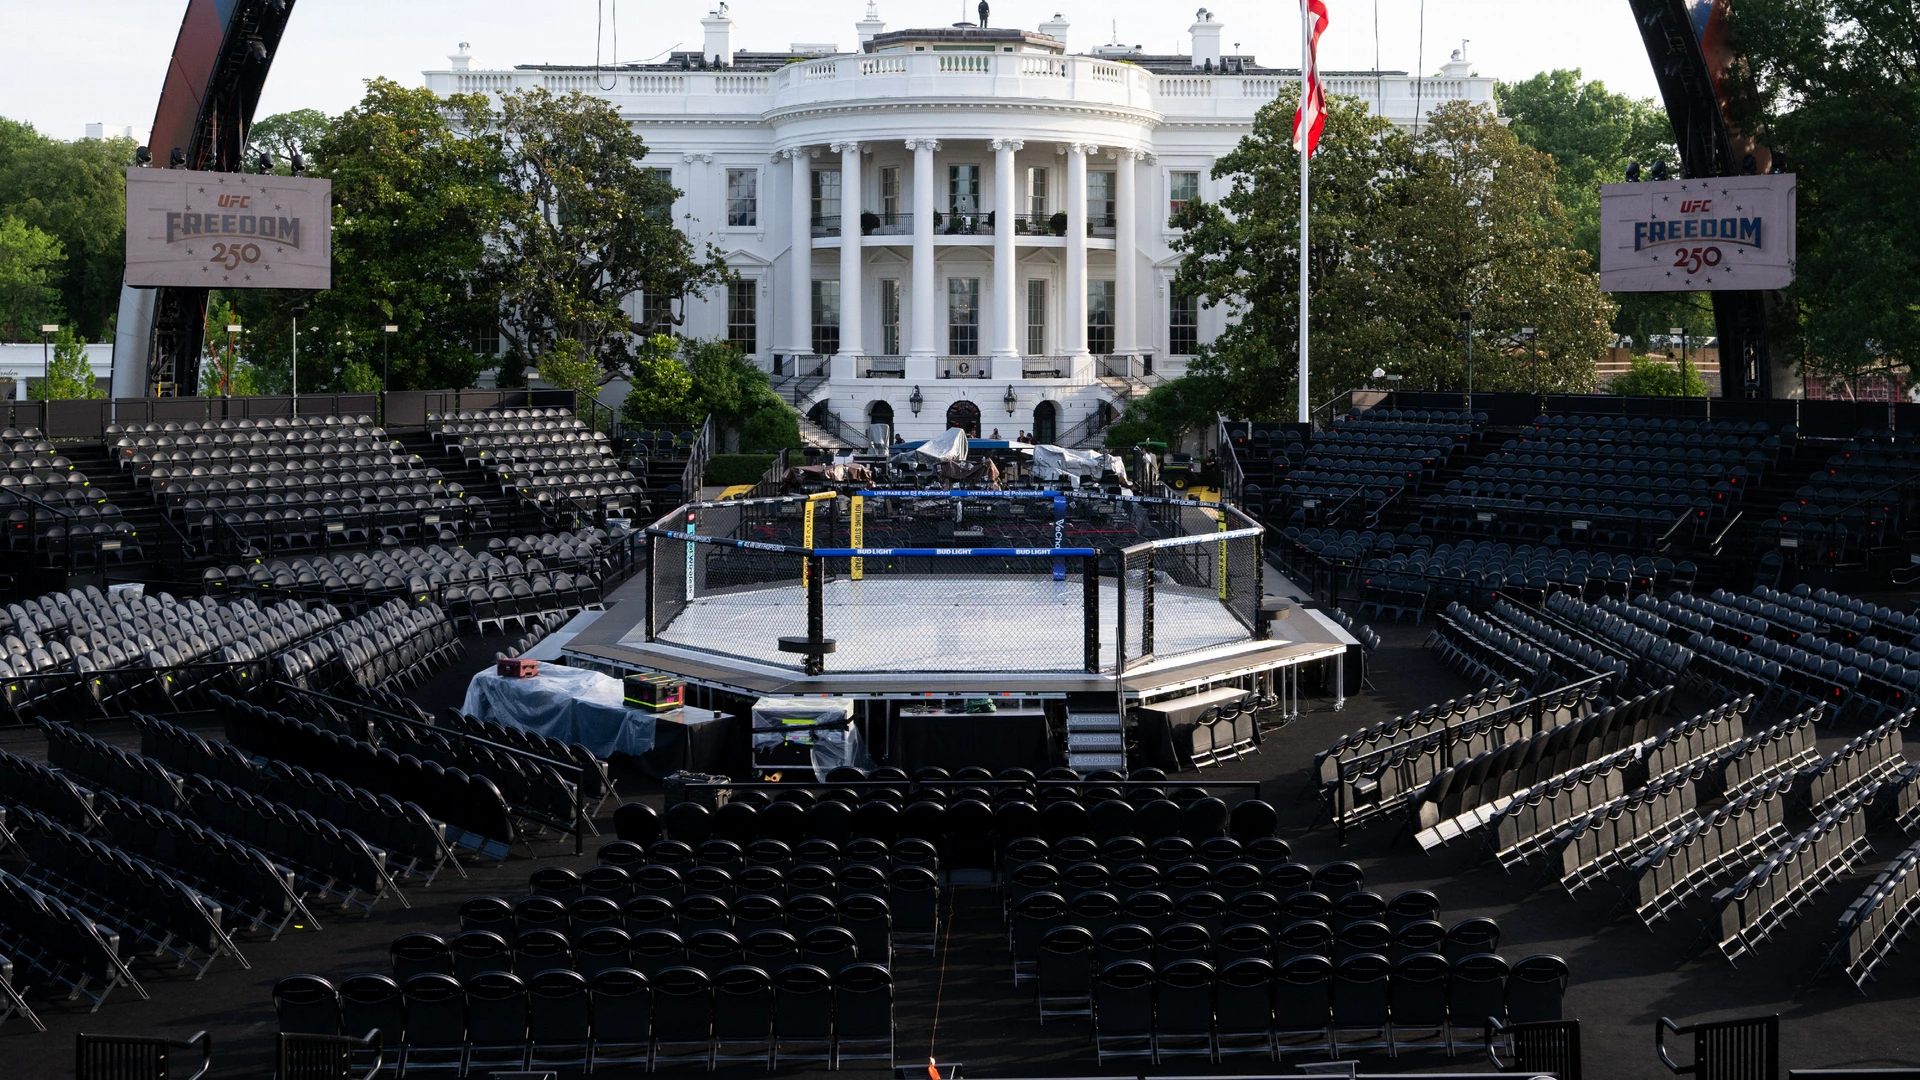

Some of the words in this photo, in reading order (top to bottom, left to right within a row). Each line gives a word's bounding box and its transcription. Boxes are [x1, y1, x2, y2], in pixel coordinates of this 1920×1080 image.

[217, 194, 251, 209] UFC
[1680, 200, 1712, 213] UFC
[166, 212, 300, 249] FREEDOM
[1634, 217, 1762, 253] FREEDOM
[210, 243, 261, 271] 250
[1673, 246, 1722, 274] 250
[0, 368, 19, 376] arden
[918, 490, 951, 498] Polymarket
[1011, 490, 1044, 498] Polymarket
[1055, 519, 1064, 548] VeCha
